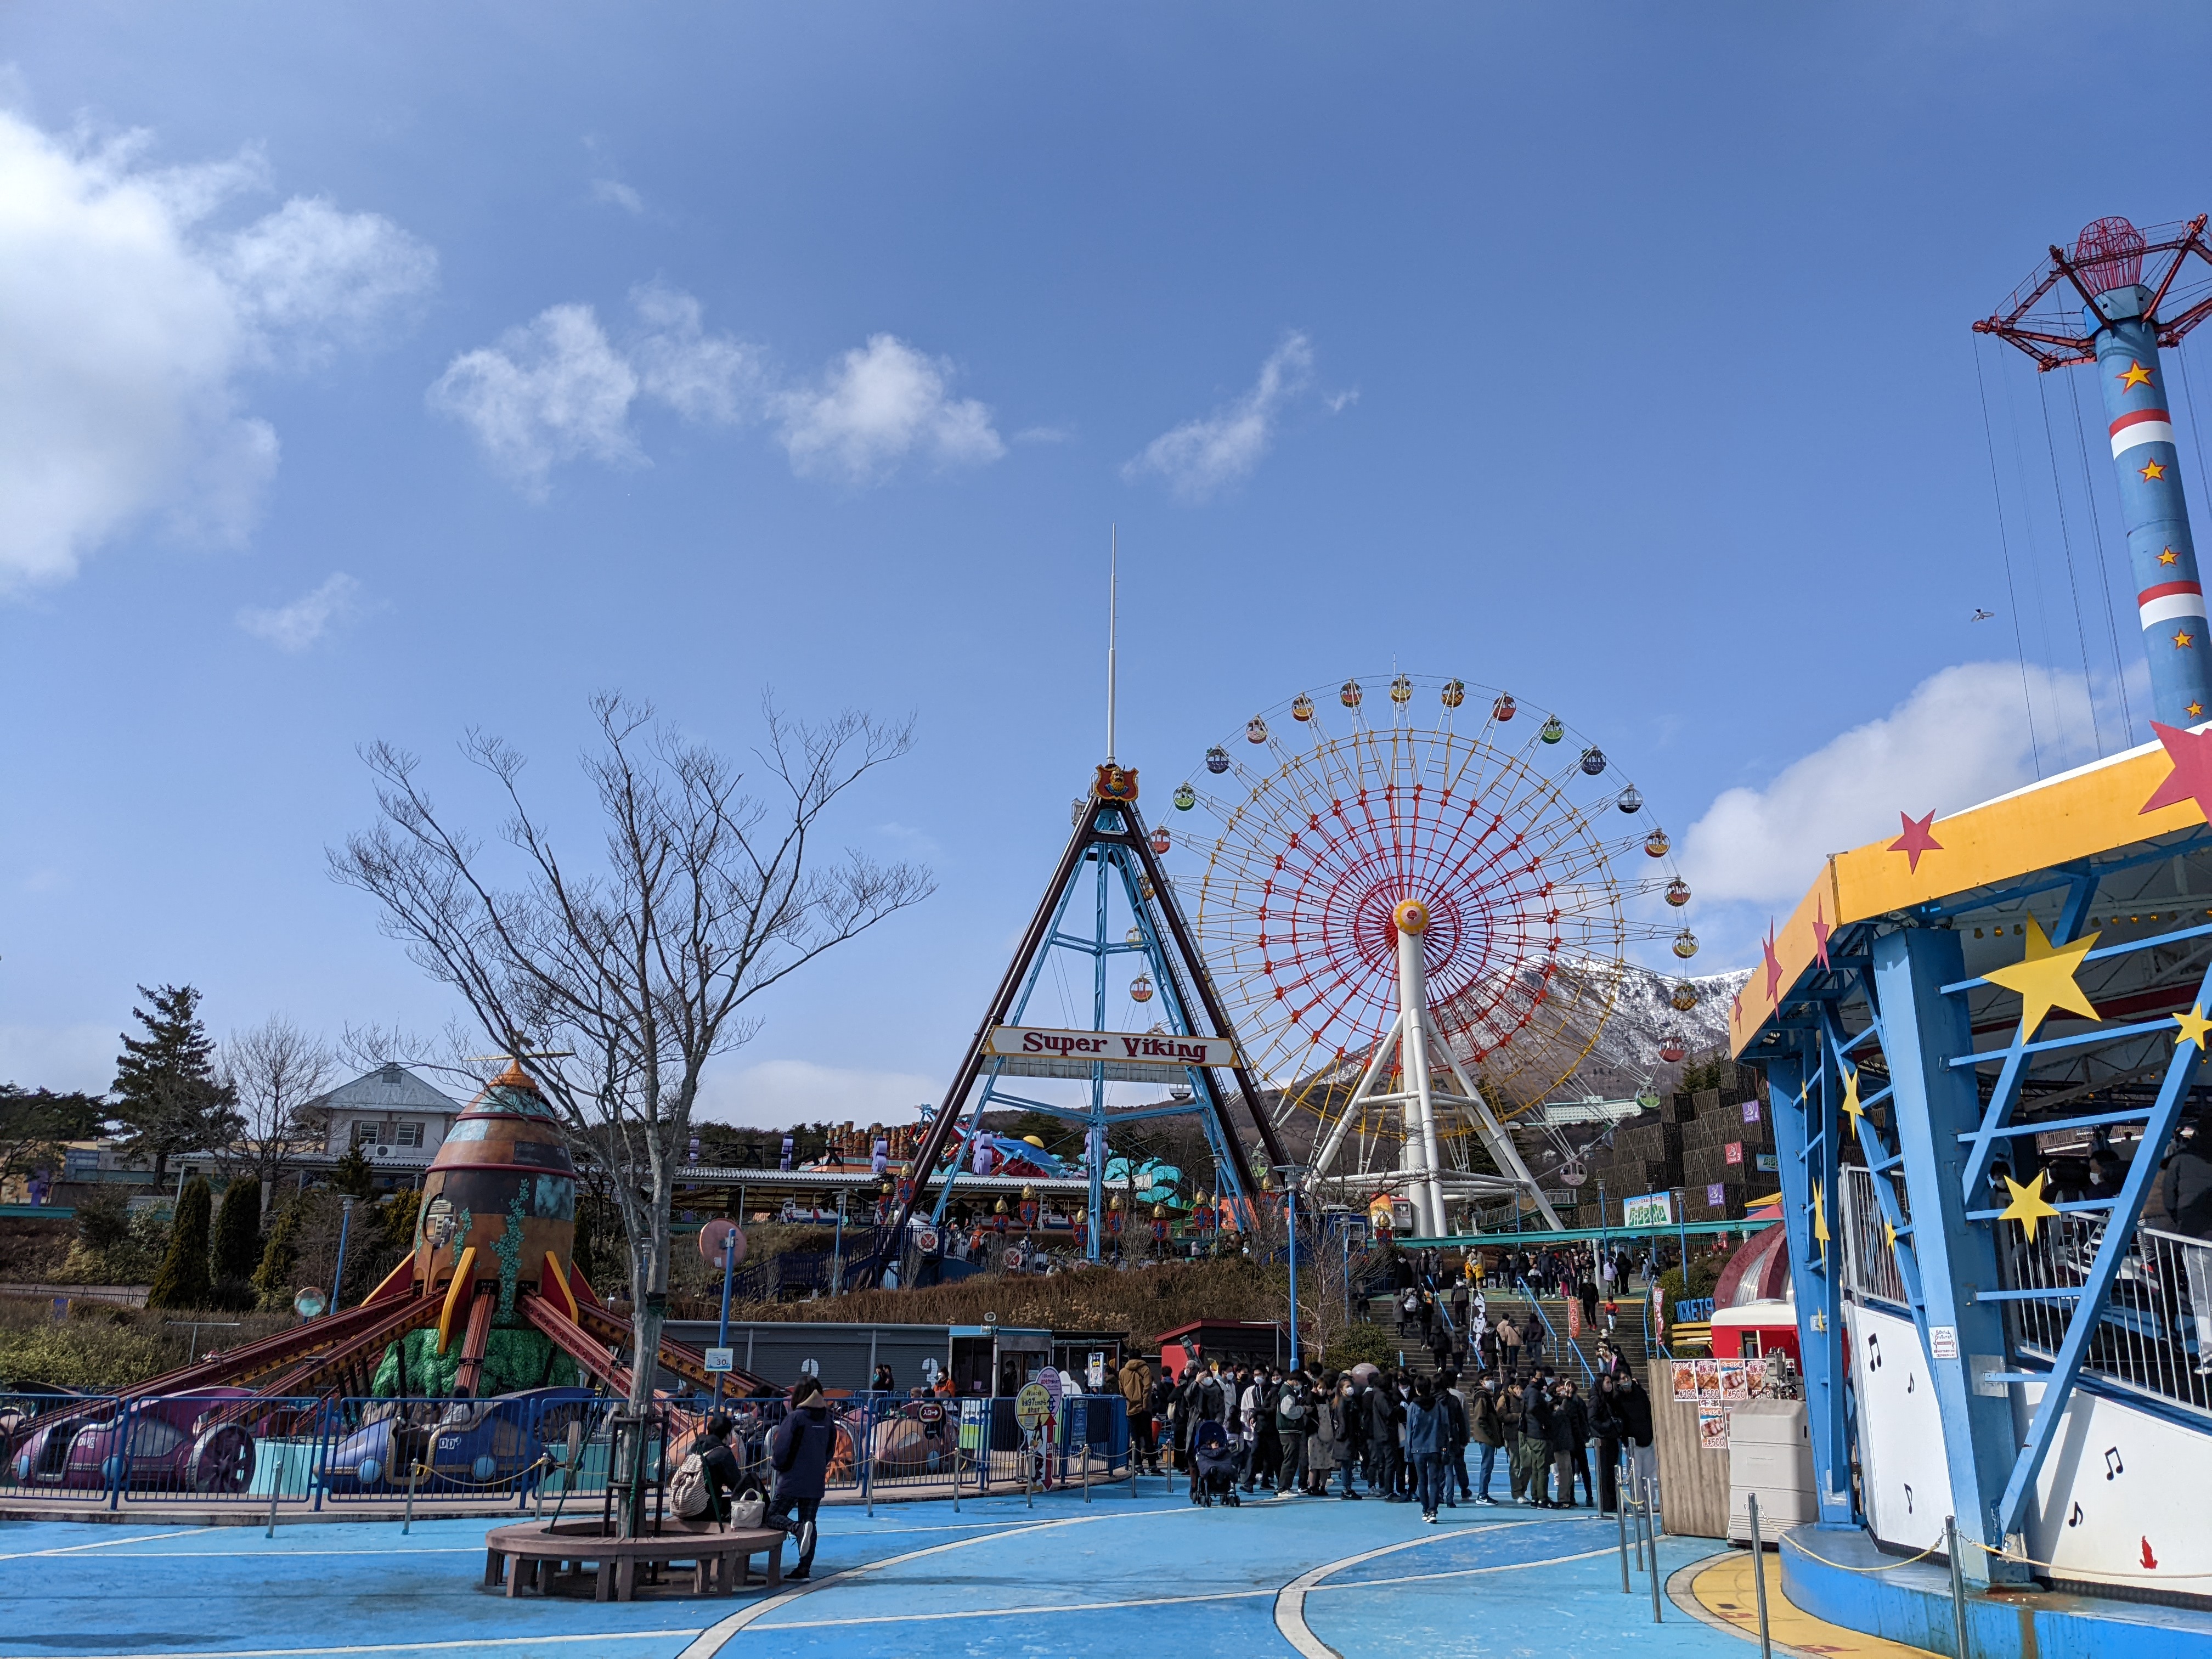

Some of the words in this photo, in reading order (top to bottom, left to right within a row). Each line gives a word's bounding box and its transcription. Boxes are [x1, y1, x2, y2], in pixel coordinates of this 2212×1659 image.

[1023, 1032, 1108, 1056] Super
[1121, 1037, 1207, 1064] Viking
[1675, 1297, 1714, 1323] TICKETS
[1699, 1364, 1716, 1373] 豚串
[1679, 1390, 1696, 1398] ¥700
[1702, 1389, 1720, 1398] ¥500
[1728, 1389, 1745, 1398] ¥500
[1707, 1437, 1724, 1447] ¥500
